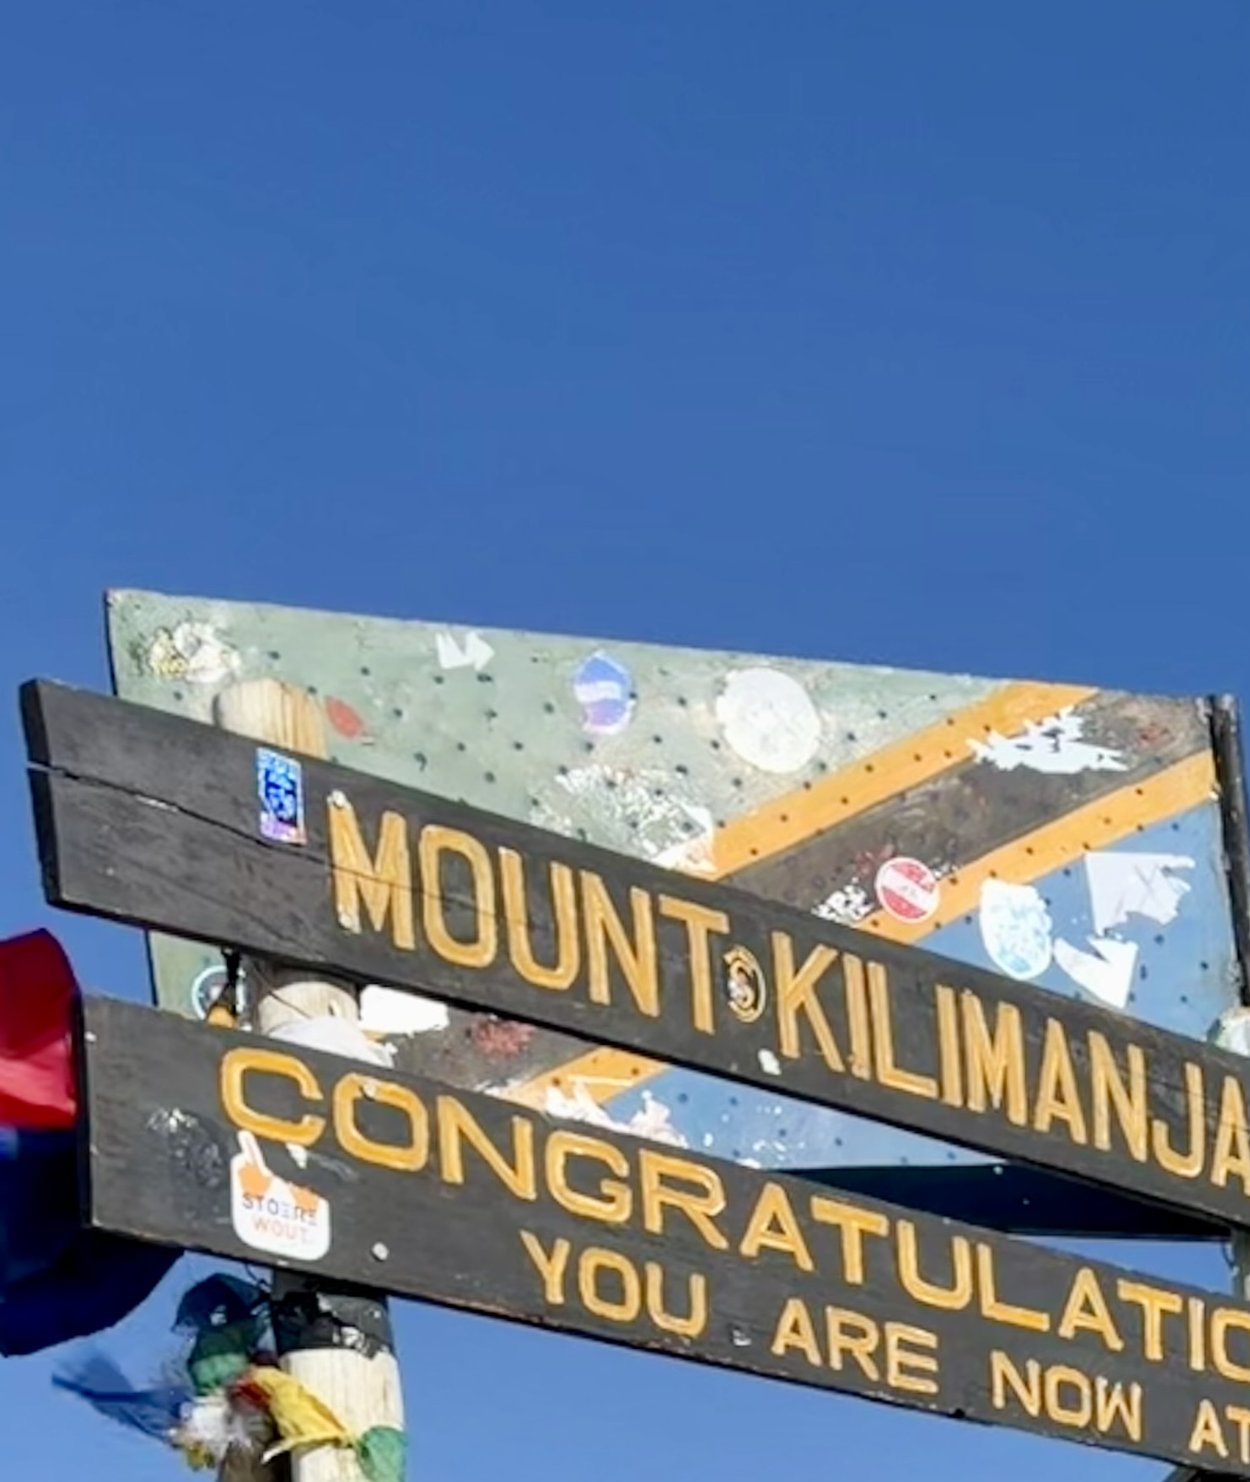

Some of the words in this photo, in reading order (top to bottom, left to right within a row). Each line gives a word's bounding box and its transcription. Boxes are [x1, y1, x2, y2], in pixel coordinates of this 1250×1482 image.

[327, 793, 730, 1036] MOUNT
[521, 1231, 708, 1339] YOU
[770, 1299, 940, 1395] ARE
[990, 1351, 1142, 1442] NOW
